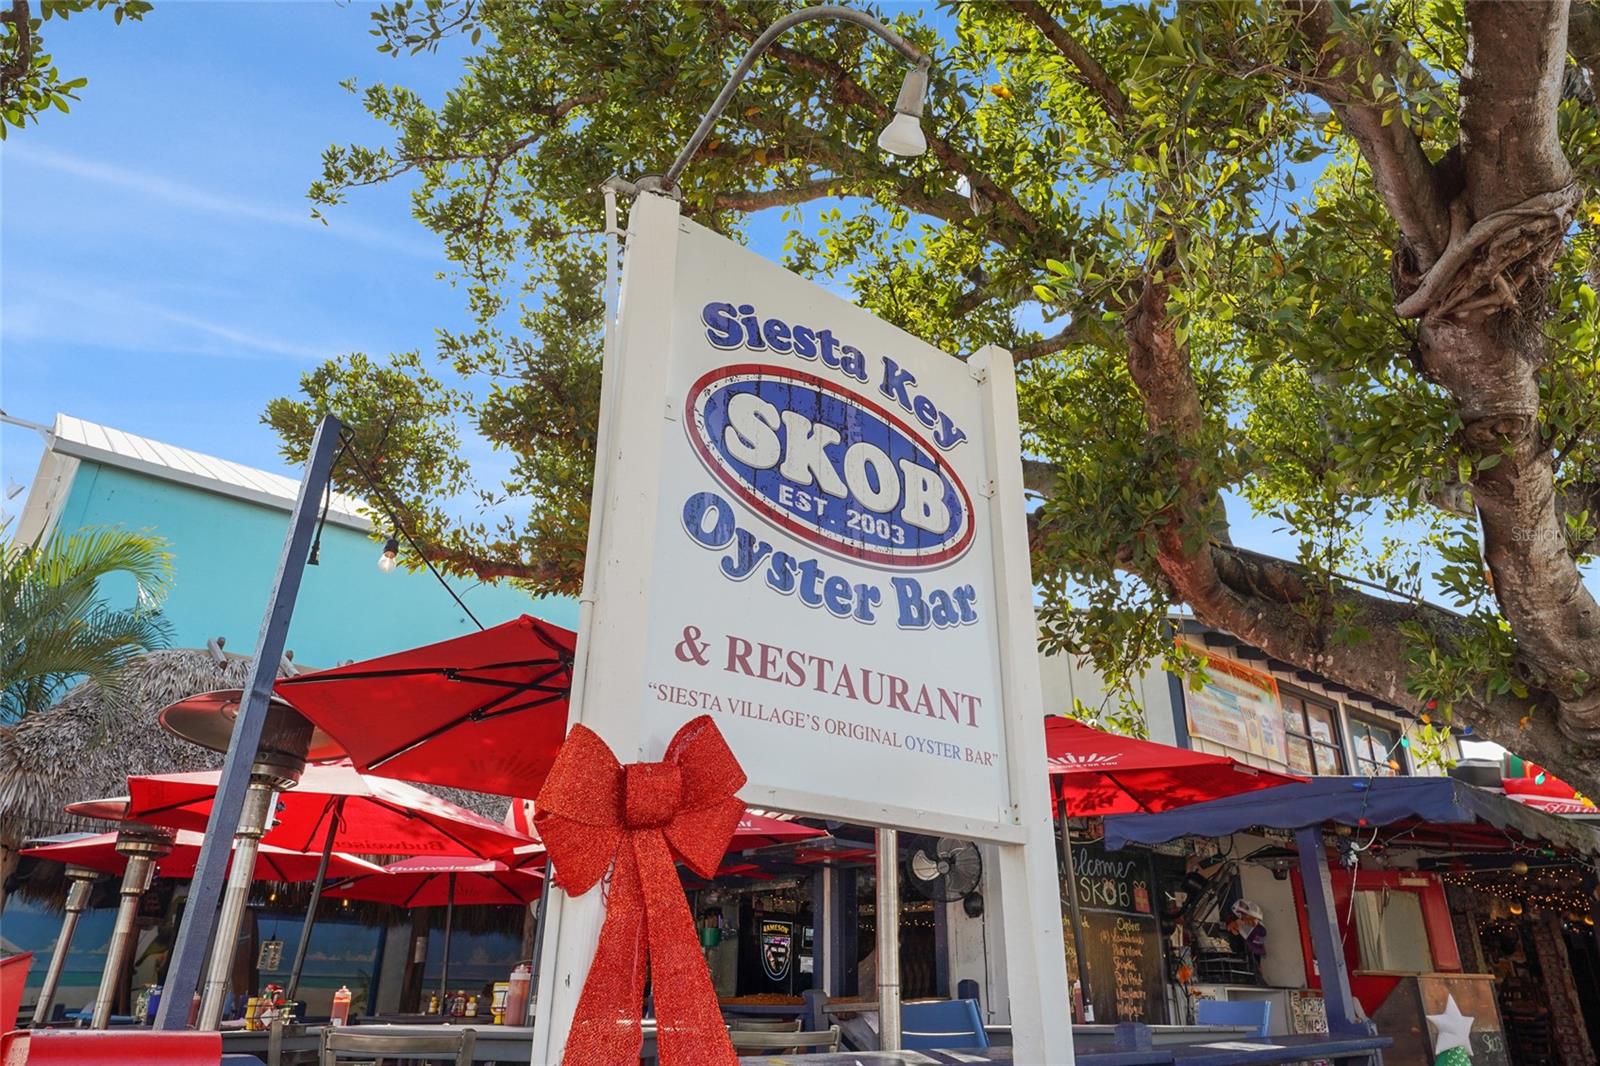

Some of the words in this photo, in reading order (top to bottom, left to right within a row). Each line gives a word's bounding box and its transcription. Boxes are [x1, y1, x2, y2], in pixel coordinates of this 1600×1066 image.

[701, 301, 869, 383] Siesta
[879, 356, 968, 451] Key
[724, 392, 951, 535] SKOB
[681, 491, 882, 625] Oyster
[891, 576, 979, 630] Bar
[846, 509, 906, 546] 2003
[674, 625, 711, 666] &
[724, 635, 983, 728] RESTAURANT
[825, 719, 902, 748] ORIGINAL
[904, 735, 961, 760] OYSTER
[1080, 876, 1130, 907] SKOB
